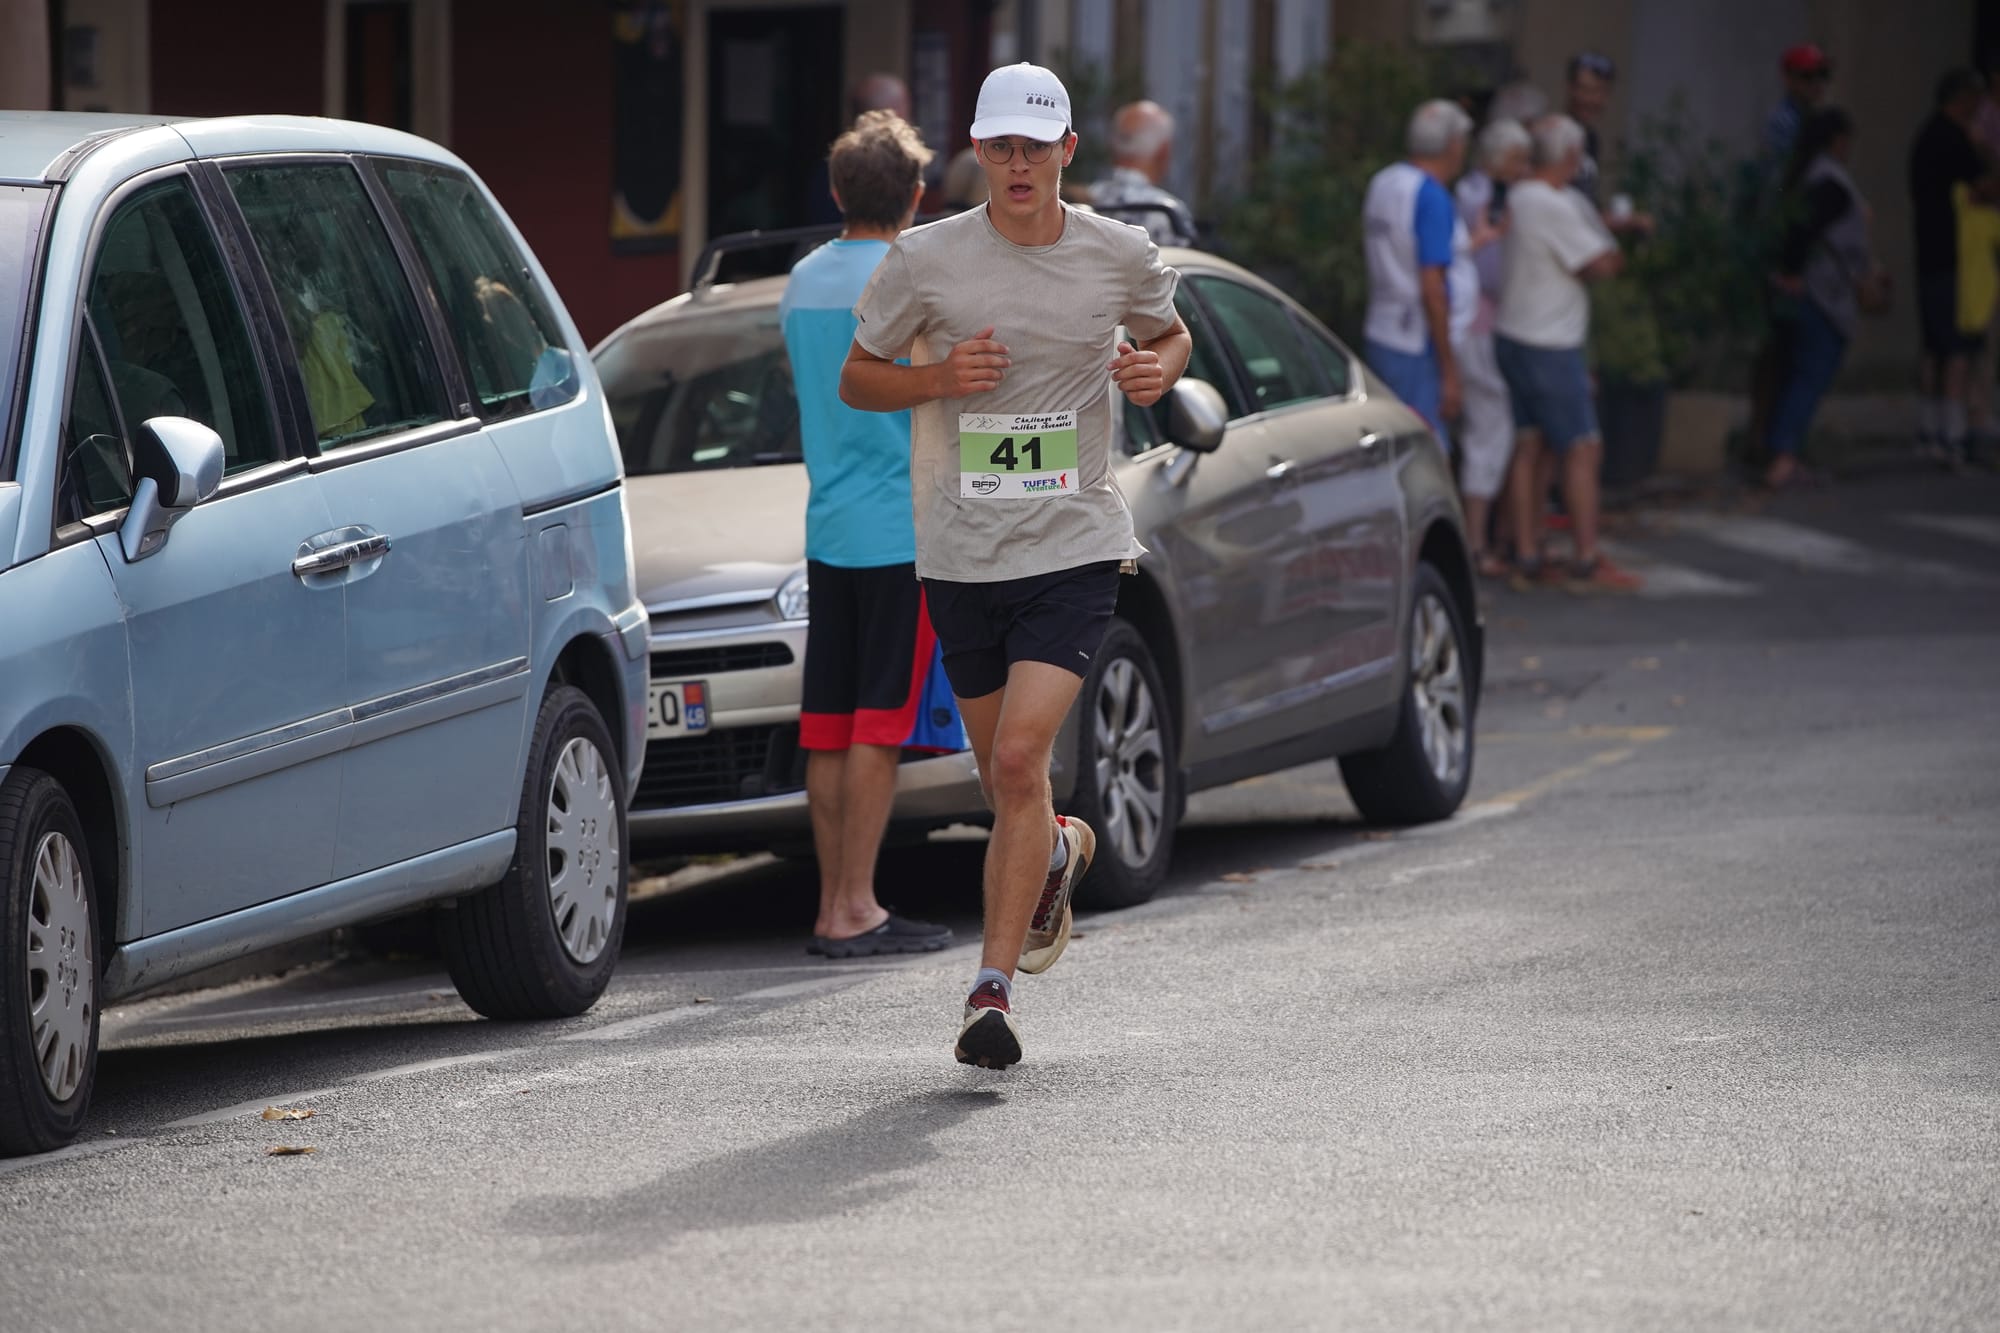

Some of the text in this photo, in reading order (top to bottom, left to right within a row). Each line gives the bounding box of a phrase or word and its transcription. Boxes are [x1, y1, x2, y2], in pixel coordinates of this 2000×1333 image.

[1014, 416, 1052, 424] Challenge
[990, 437, 1041, 470] 41
[972, 480, 997, 488] BFP
[1022, 478, 1057, 488] TUFF'S
[1025, 484, 1060, 492] Aventure
[687, 707, 705, 726] 48
